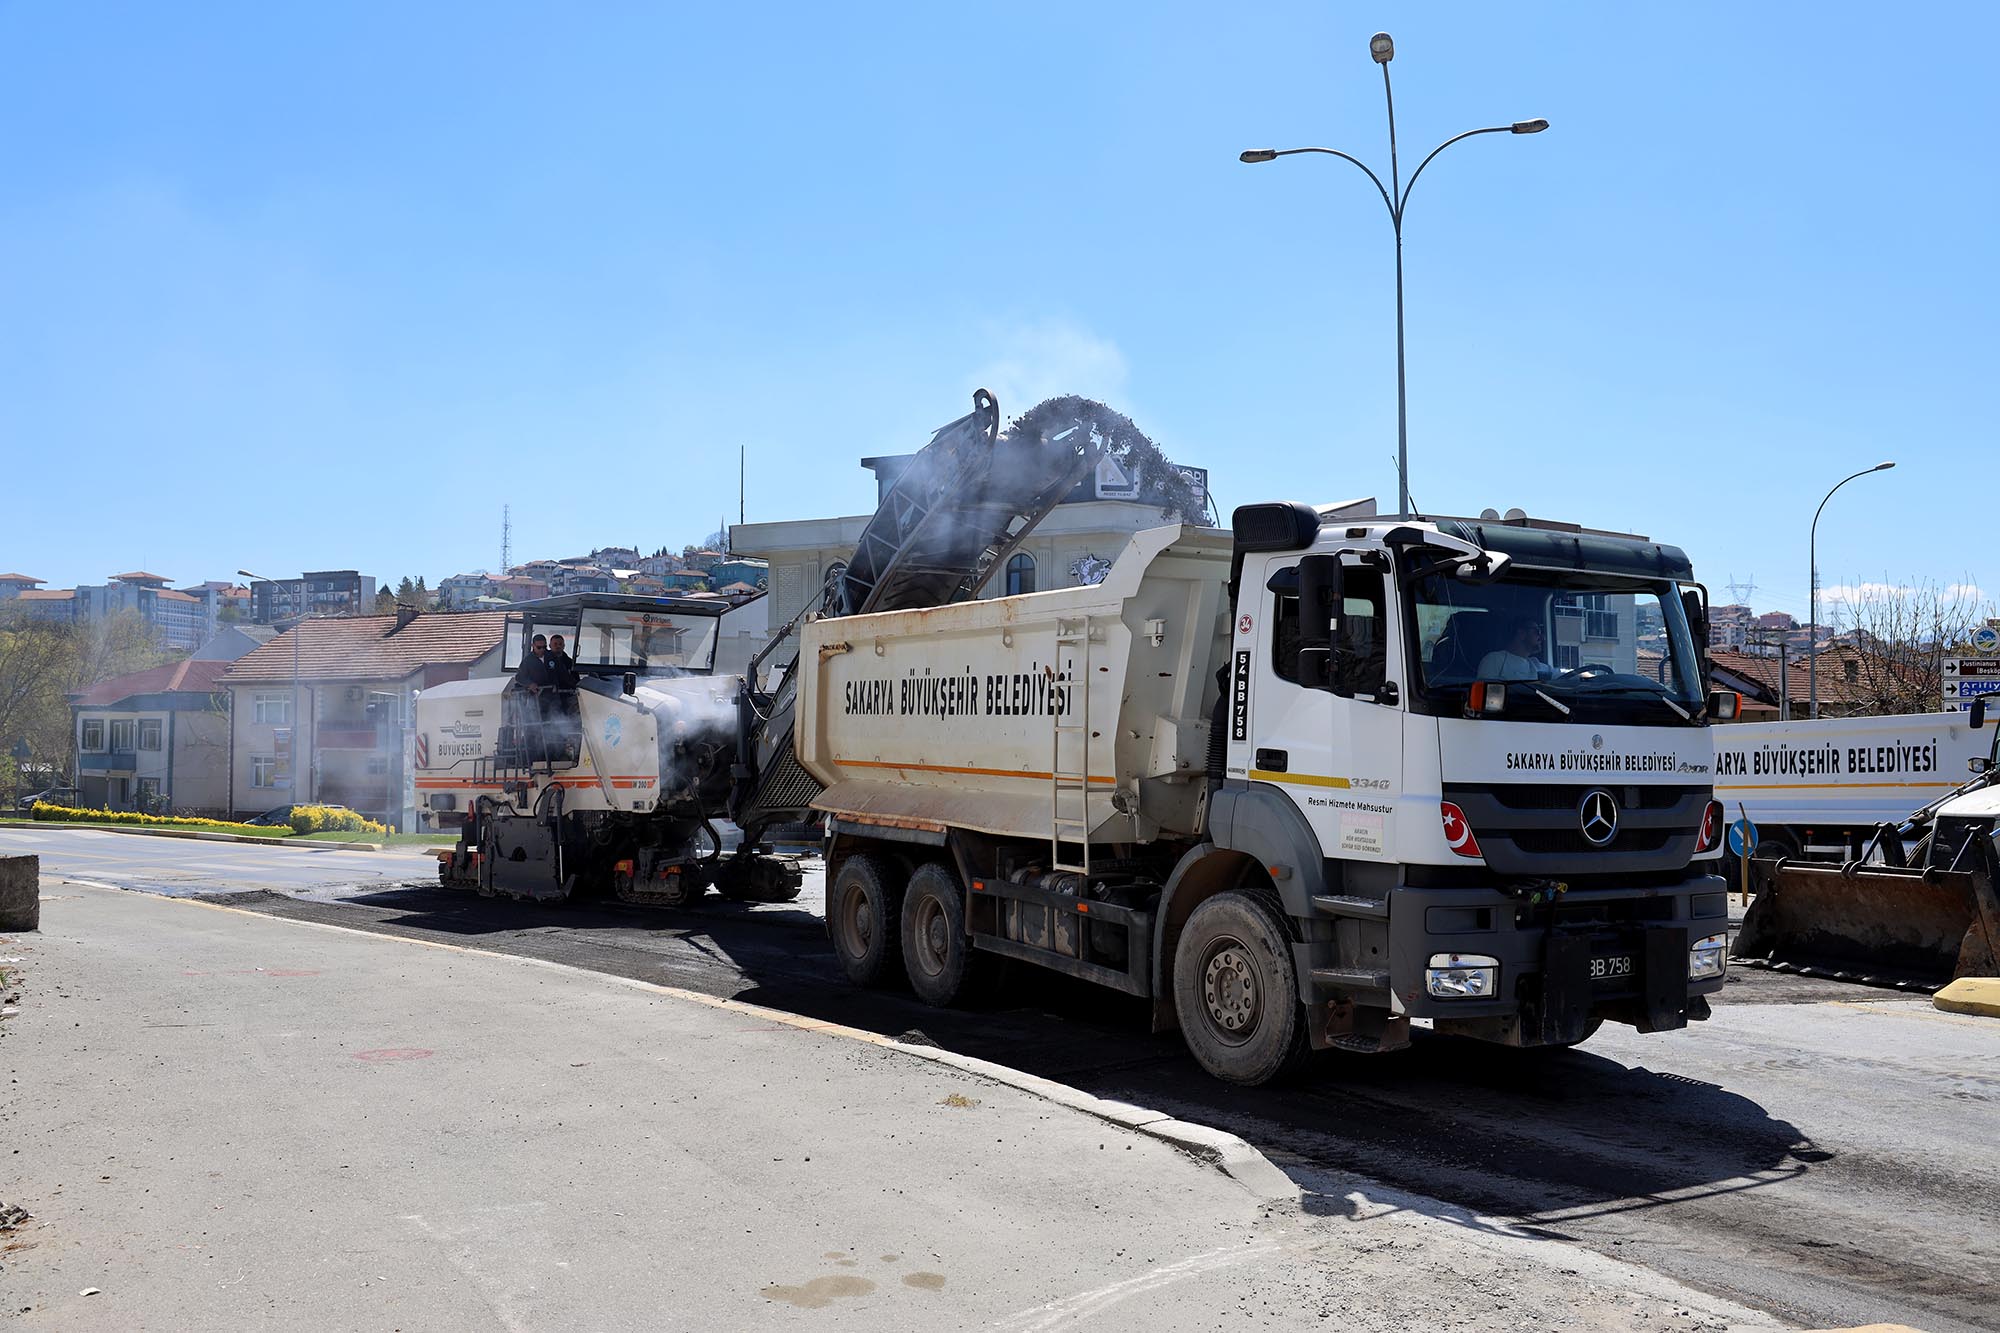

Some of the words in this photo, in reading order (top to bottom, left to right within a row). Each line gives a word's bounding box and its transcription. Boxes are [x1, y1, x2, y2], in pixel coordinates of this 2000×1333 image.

[1239, 654, 1246, 675] 54
[845, 679, 894, 715] SAKARYA
[900, 665, 978, 721] BÜYÜKŞEHİR
[986, 659, 1072, 716] BELEDİYESİ
[1237, 681, 1245, 701] BB
[1236, 705, 1244, 737] 758
[438, 740, 482, 757] BÜYÜKŞEHİR
[1713, 752, 1747, 776] ARYA
[1753, 742, 1840, 778] BÜYÜKŞEHİR
[1848, 738, 1937, 773] BELEDİYESİ
[1506, 753, 1555, 770] SAKARYA
[1560, 750, 1621, 773] BÜYÜKŞEHİR
[1625, 751, 1676, 771] BELEDİYESİ
[1308, 796, 1328, 806] Resmi
[1328, 799, 1355, 810] Hizmete
[1356, 801, 1393, 814] Mahsustur
[1609, 956, 1630, 975] 758
